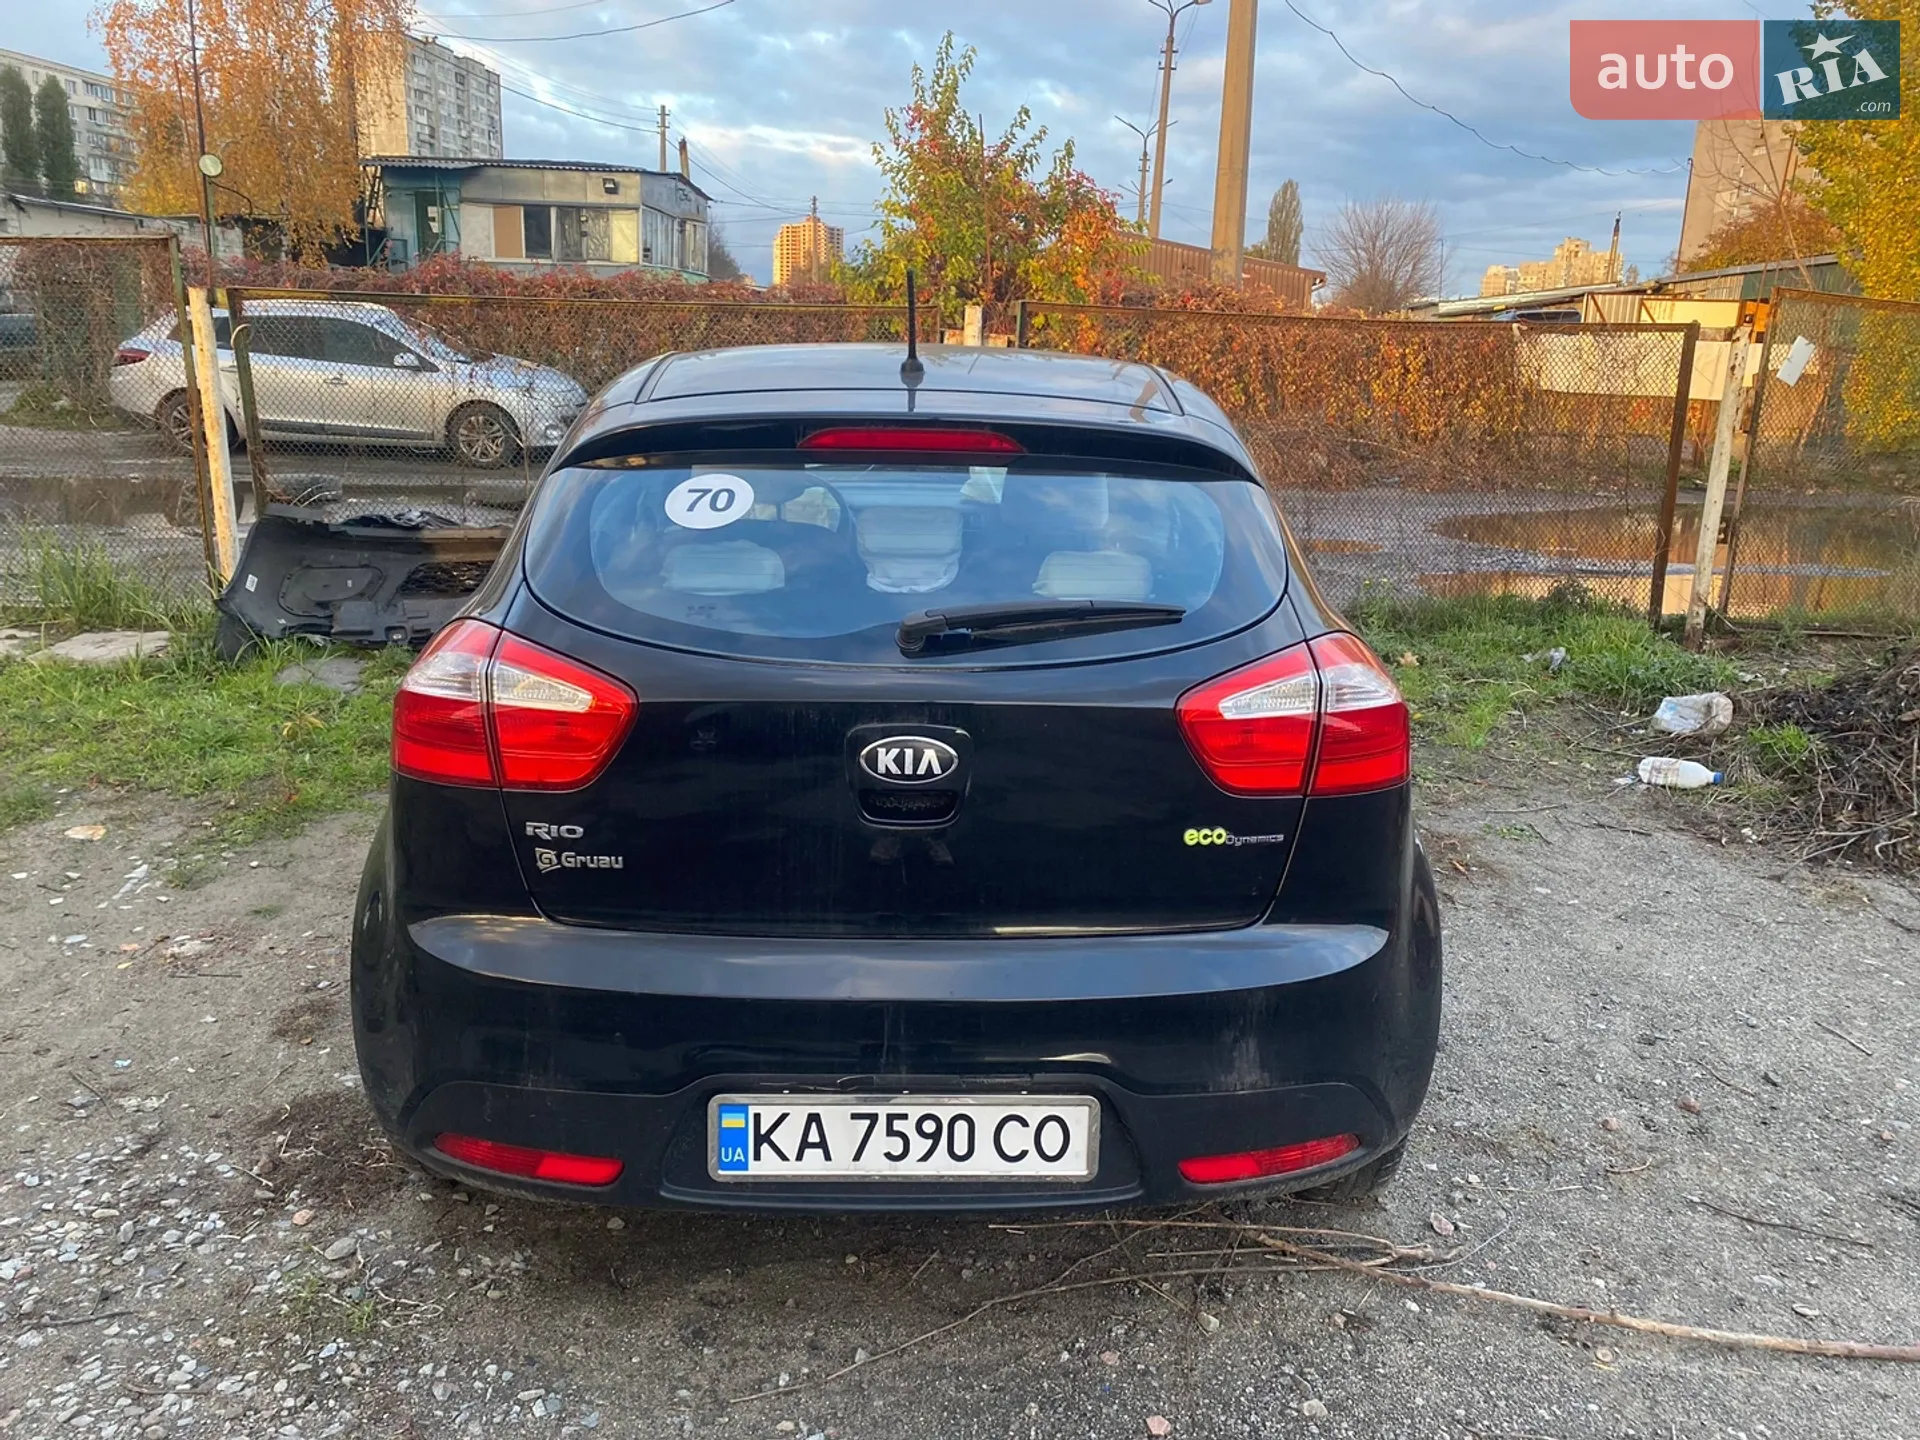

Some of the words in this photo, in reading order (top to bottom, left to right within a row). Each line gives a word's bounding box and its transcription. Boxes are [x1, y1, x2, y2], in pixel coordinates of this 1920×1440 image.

[686, 488, 736, 512] 70
[877, 747, 942, 775] KIA
[525, 821, 584, 840] RIO
[561, 852, 624, 869] Gruau
[752, 1112, 832, 1162] KA
[850, 1112, 976, 1163] 7590
[993, 1113, 1071, 1163] CO
[721, 1146, 745, 1162] UA
